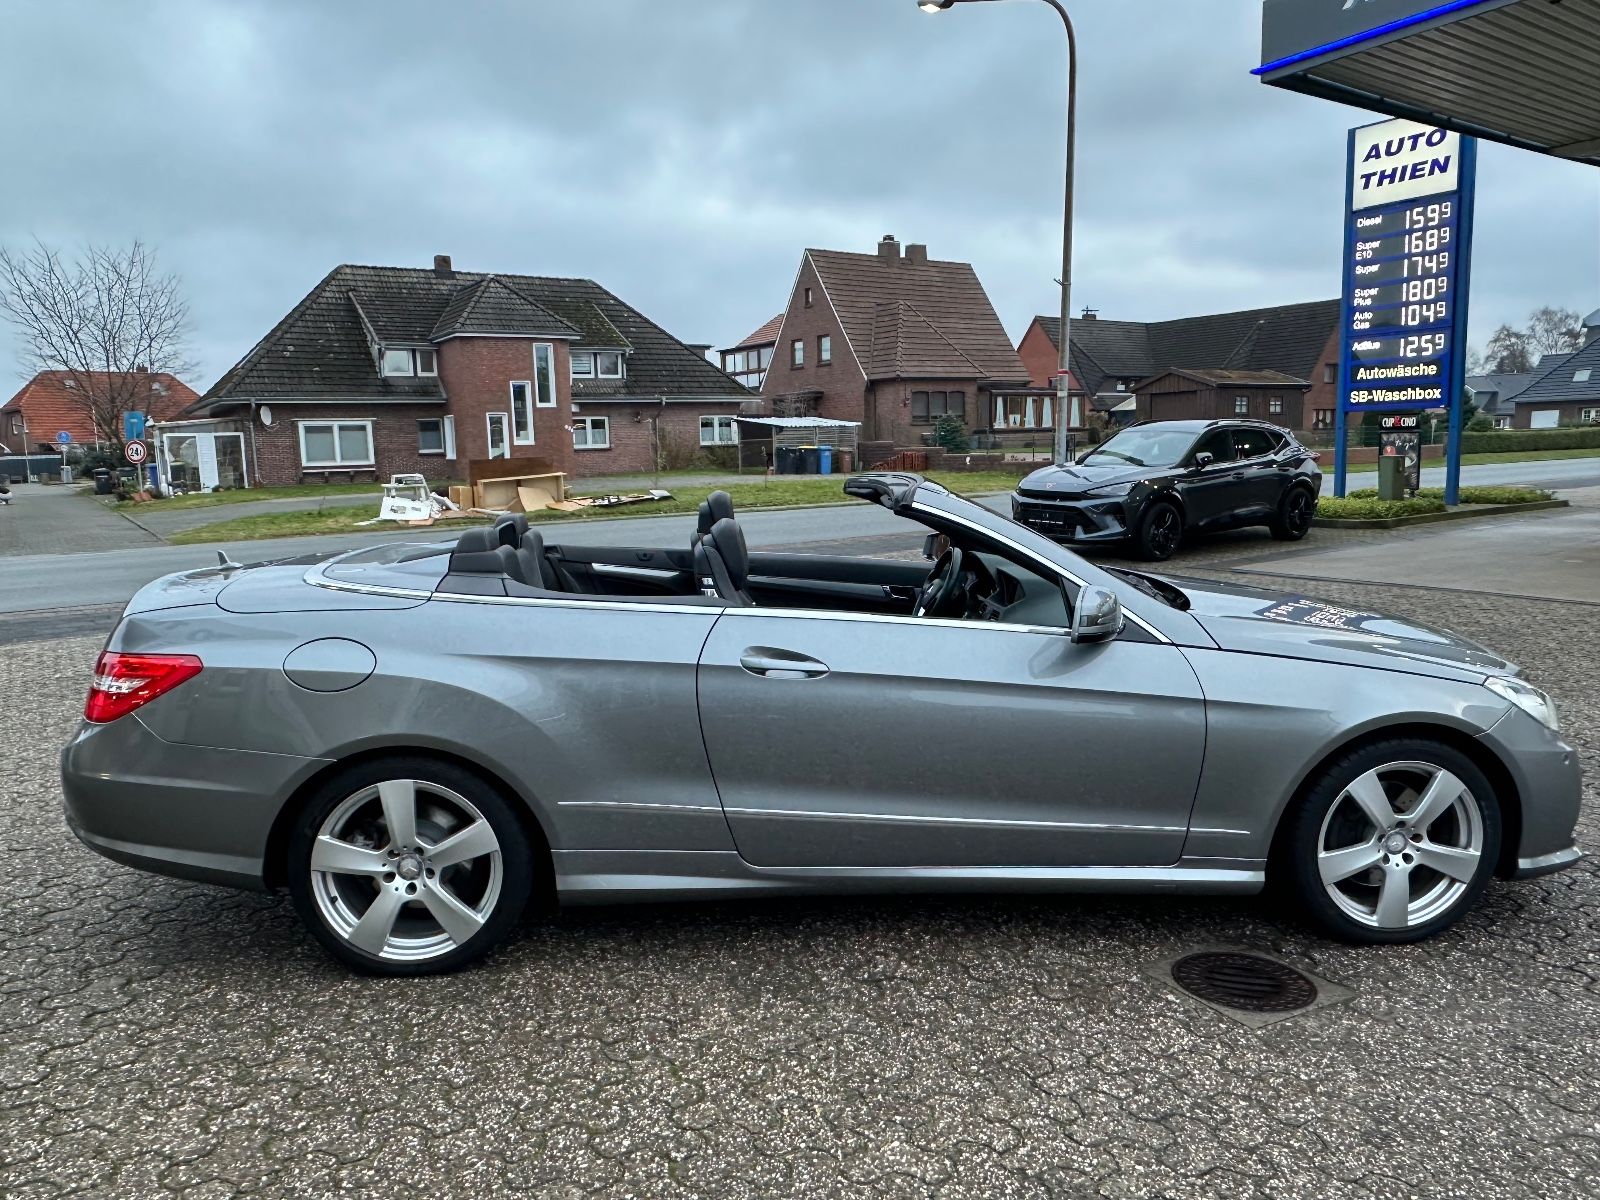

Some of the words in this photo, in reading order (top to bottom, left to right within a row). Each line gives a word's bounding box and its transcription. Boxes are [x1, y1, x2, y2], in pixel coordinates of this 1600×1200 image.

[1362, 128, 1447, 162] AUTO
[1360, 155, 1451, 190] THIEN
[1356, 214, 1382, 227] Diesel
[1356, 240, 1381, 251] Super
[1355, 250, 1373, 260] E10
[1355, 264, 1380, 274] Super
[1354, 288, 1379, 298] Super
[1353, 298, 1372, 306] Plus
[1353, 311, 1373, 321] Auto
[1353, 321, 1371, 330] Gas
[1356, 363, 1437, 380] Autowäsche
[1350, 387, 1442, 403] SB-Waschbox
